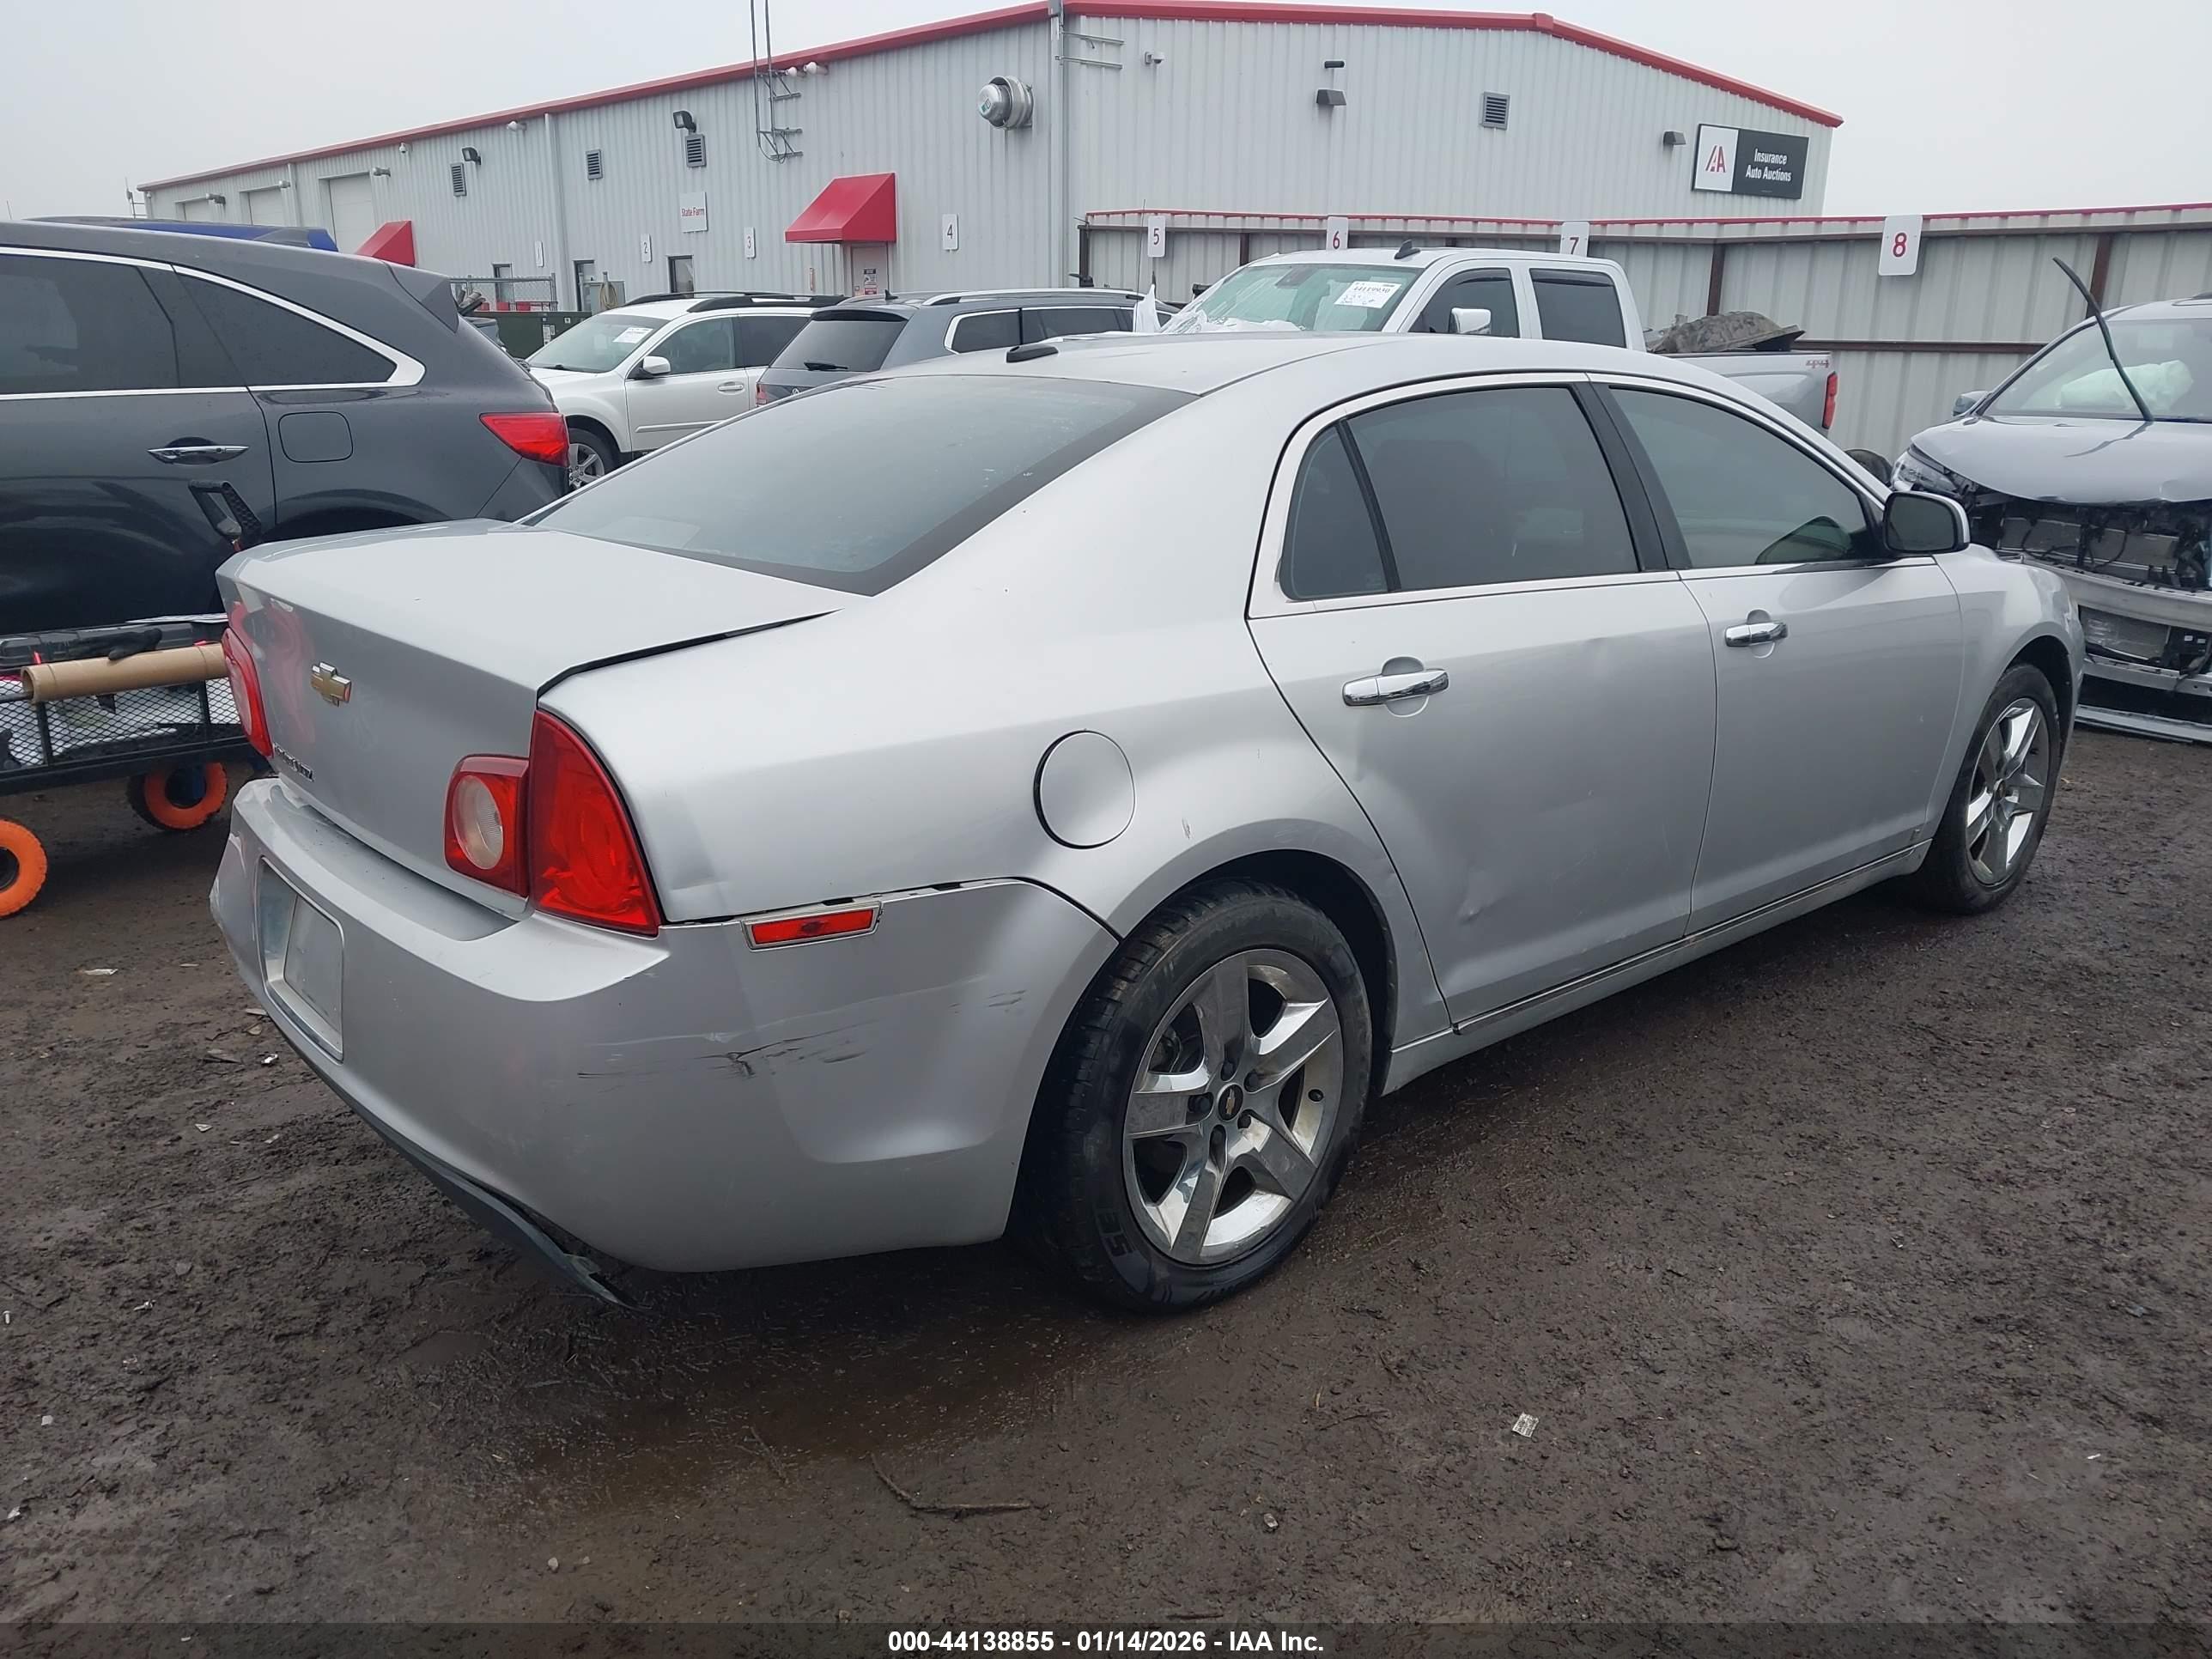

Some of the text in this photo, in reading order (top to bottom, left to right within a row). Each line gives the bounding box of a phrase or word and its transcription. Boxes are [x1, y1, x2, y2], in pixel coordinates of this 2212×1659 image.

[1754, 148, 1788, 165] Insurance
[1745, 164, 1792, 182] Auto Auctions
[946, 224, 953, 240] 4
[1153, 228, 1160, 246] 5
[1333, 230, 1340, 250] 6
[1570, 236, 1580, 255] 7
[1893, 232, 1907, 258] 8
